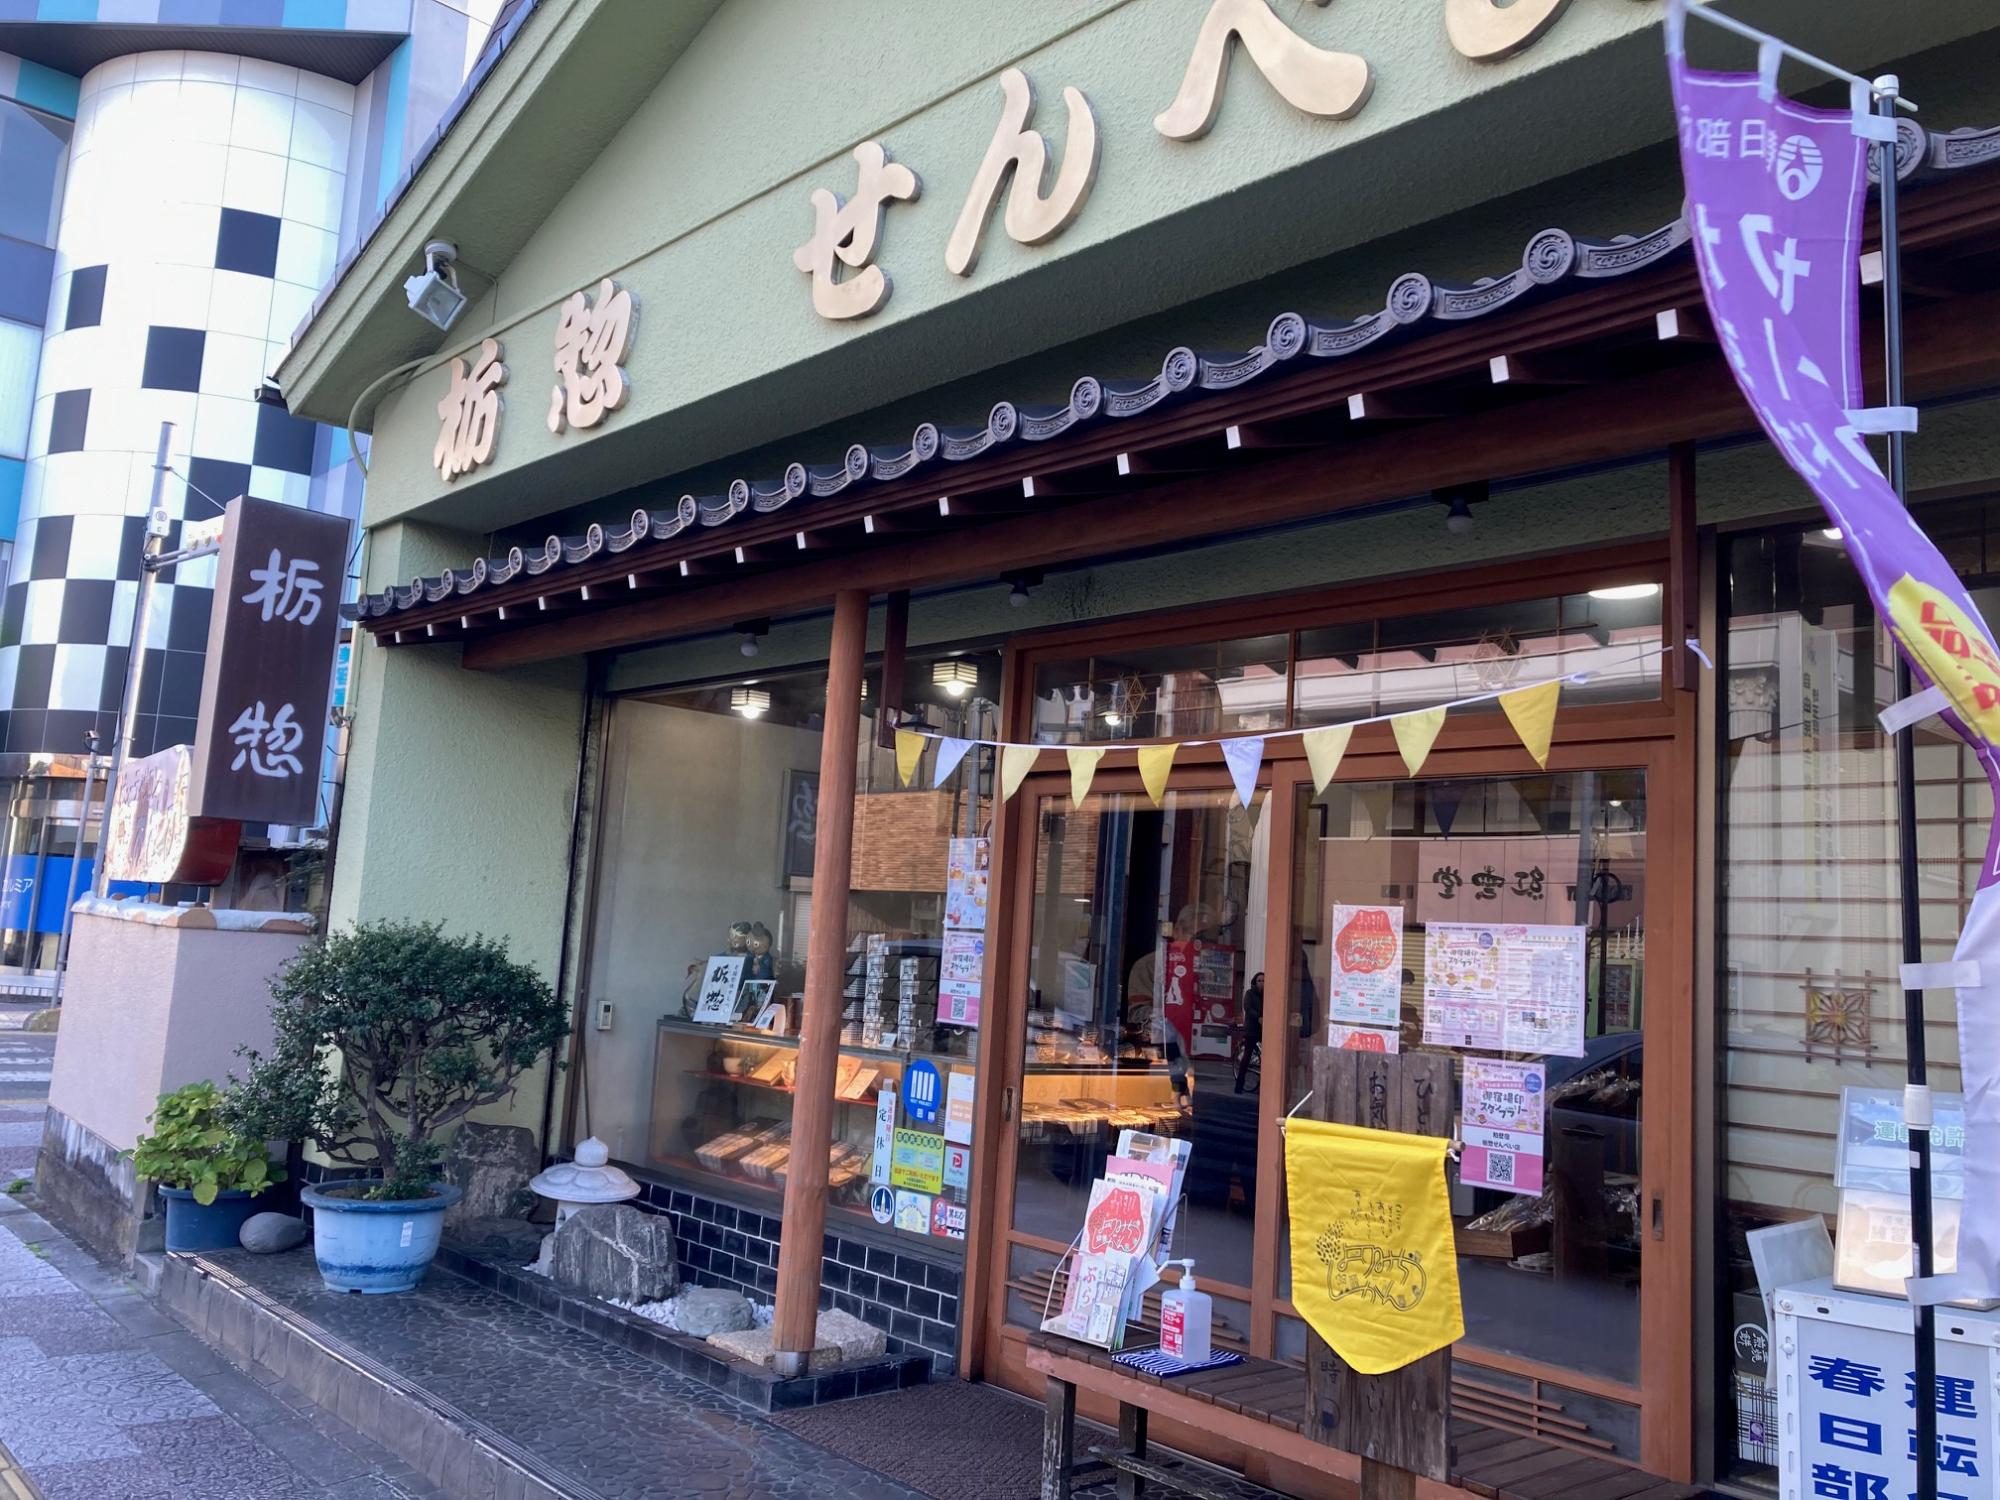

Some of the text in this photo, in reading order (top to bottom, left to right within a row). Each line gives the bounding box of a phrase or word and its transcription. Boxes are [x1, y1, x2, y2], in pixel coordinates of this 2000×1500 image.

[793, 0, 1650, 321] せんべ
[229, 548, 324, 778] 栃惣
[875, 1109, 887, 1177] 定休日
[1480, 1102, 1529, 1119] スタンプラリー
[1808, 1355, 1888, 1500] 春日部
[1904, 1371, 1980, 1500] 運転
